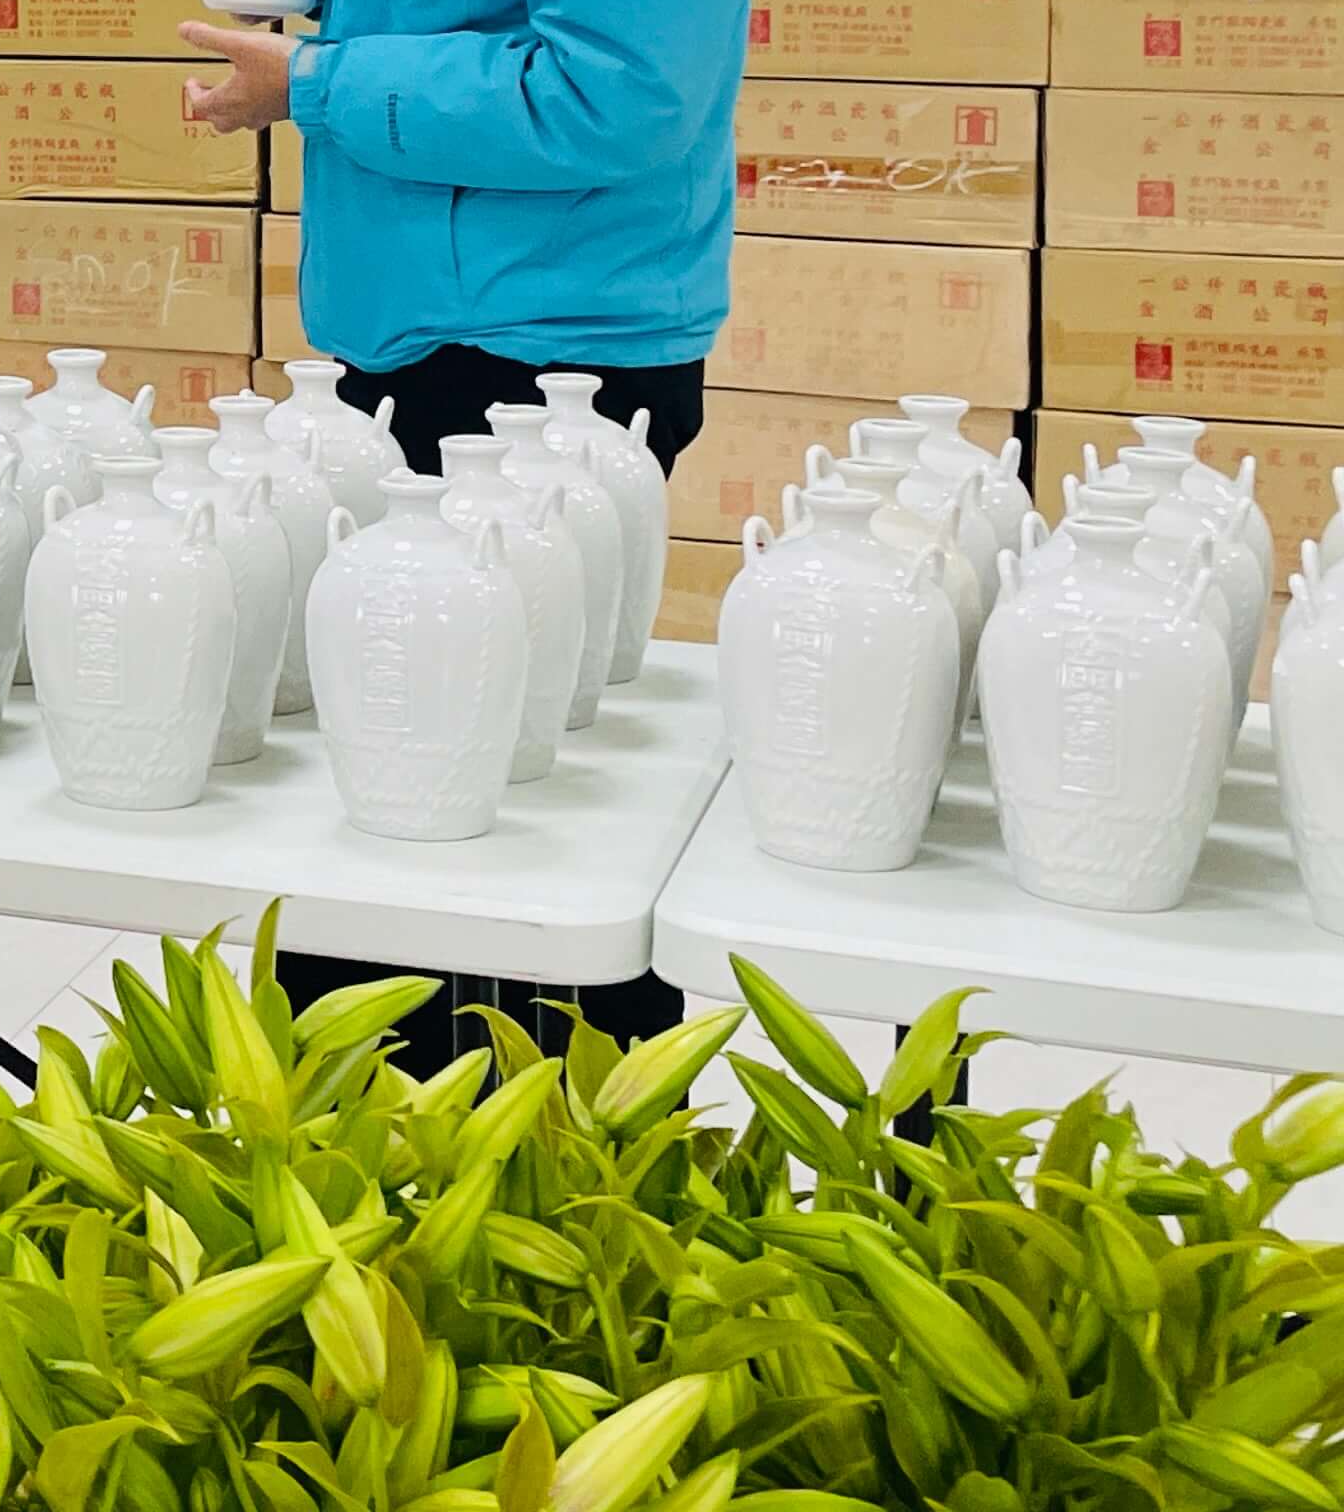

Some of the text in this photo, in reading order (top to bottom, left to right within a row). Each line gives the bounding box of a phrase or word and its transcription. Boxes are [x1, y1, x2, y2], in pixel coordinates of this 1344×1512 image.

[736, 98, 898, 119] 公升酒瓷瓶
